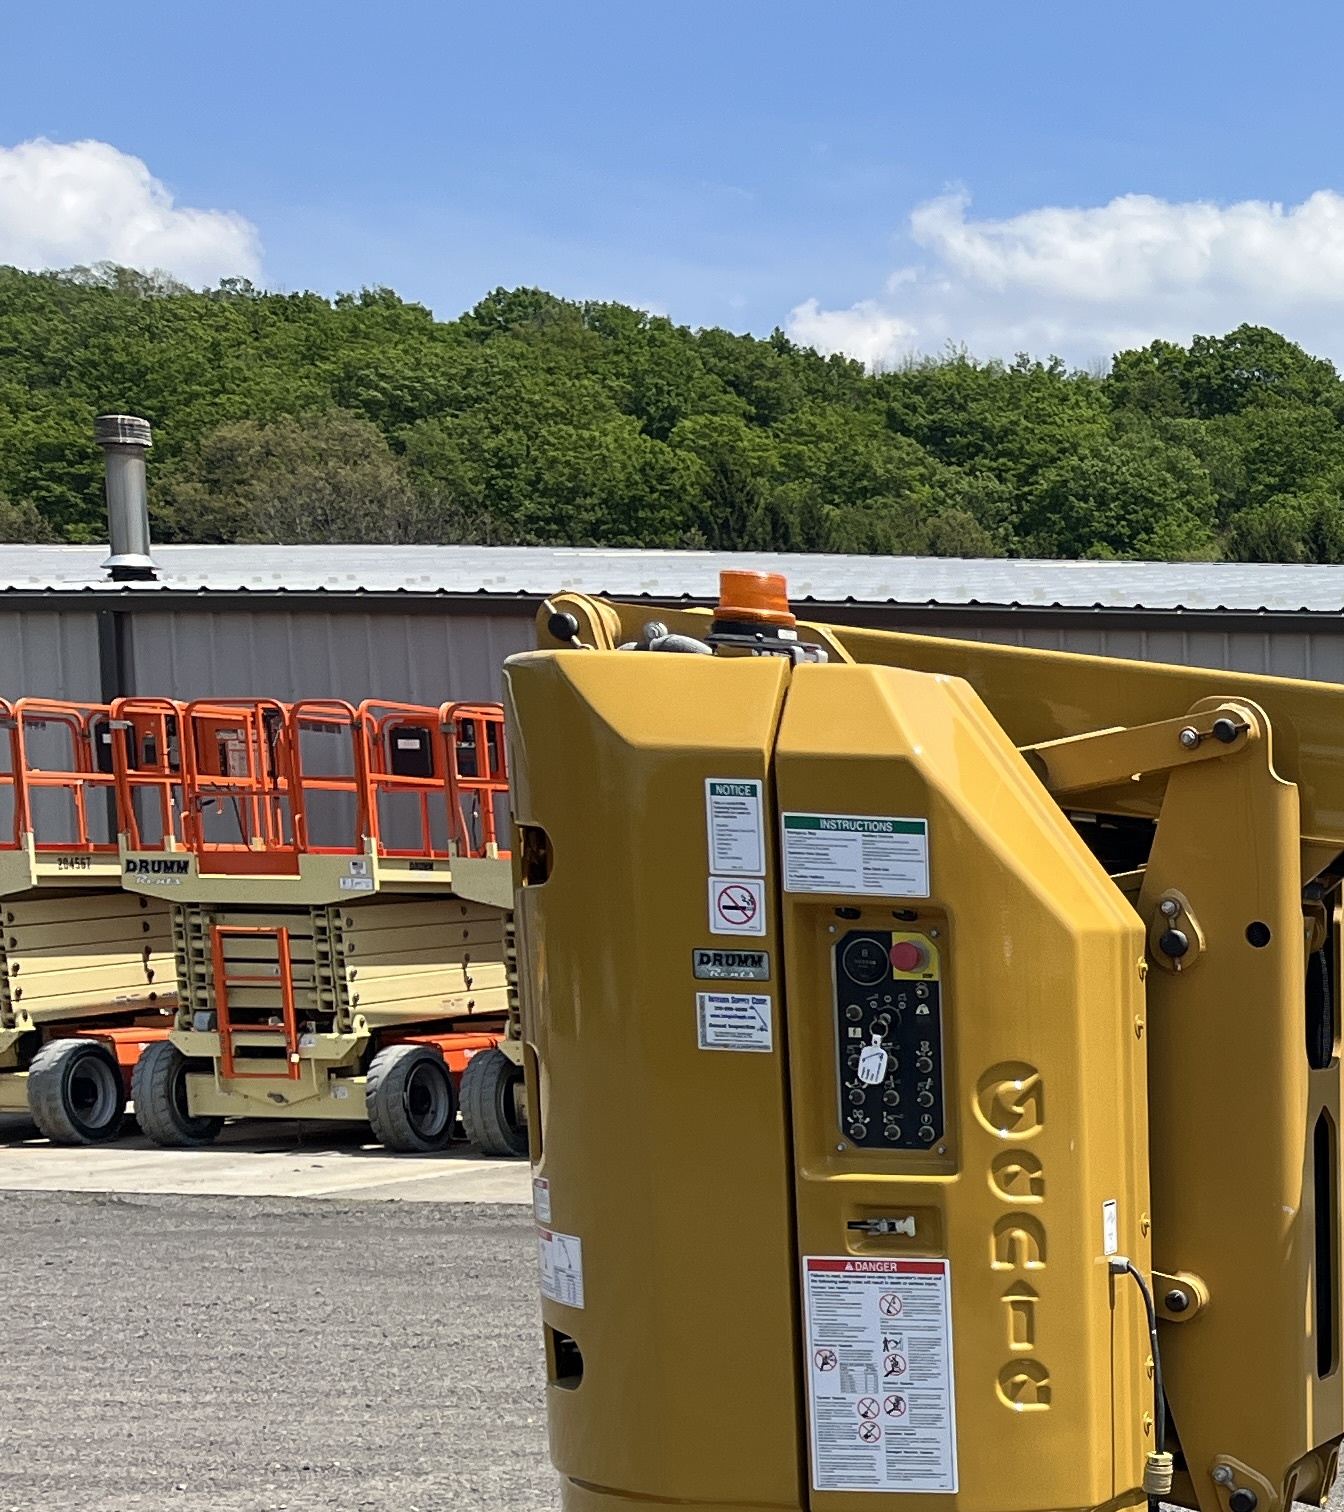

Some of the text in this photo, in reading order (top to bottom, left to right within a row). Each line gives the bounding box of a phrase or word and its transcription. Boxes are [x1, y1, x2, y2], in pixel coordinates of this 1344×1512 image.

[715, 784, 752, 796] NOTICE
[819, 818, 894, 832] INSTRUCTIONS
[125, 859, 189, 874] DRUMM
[697, 952, 764, 968] DRUMM
[855, 1261, 898, 1272] DANGER
